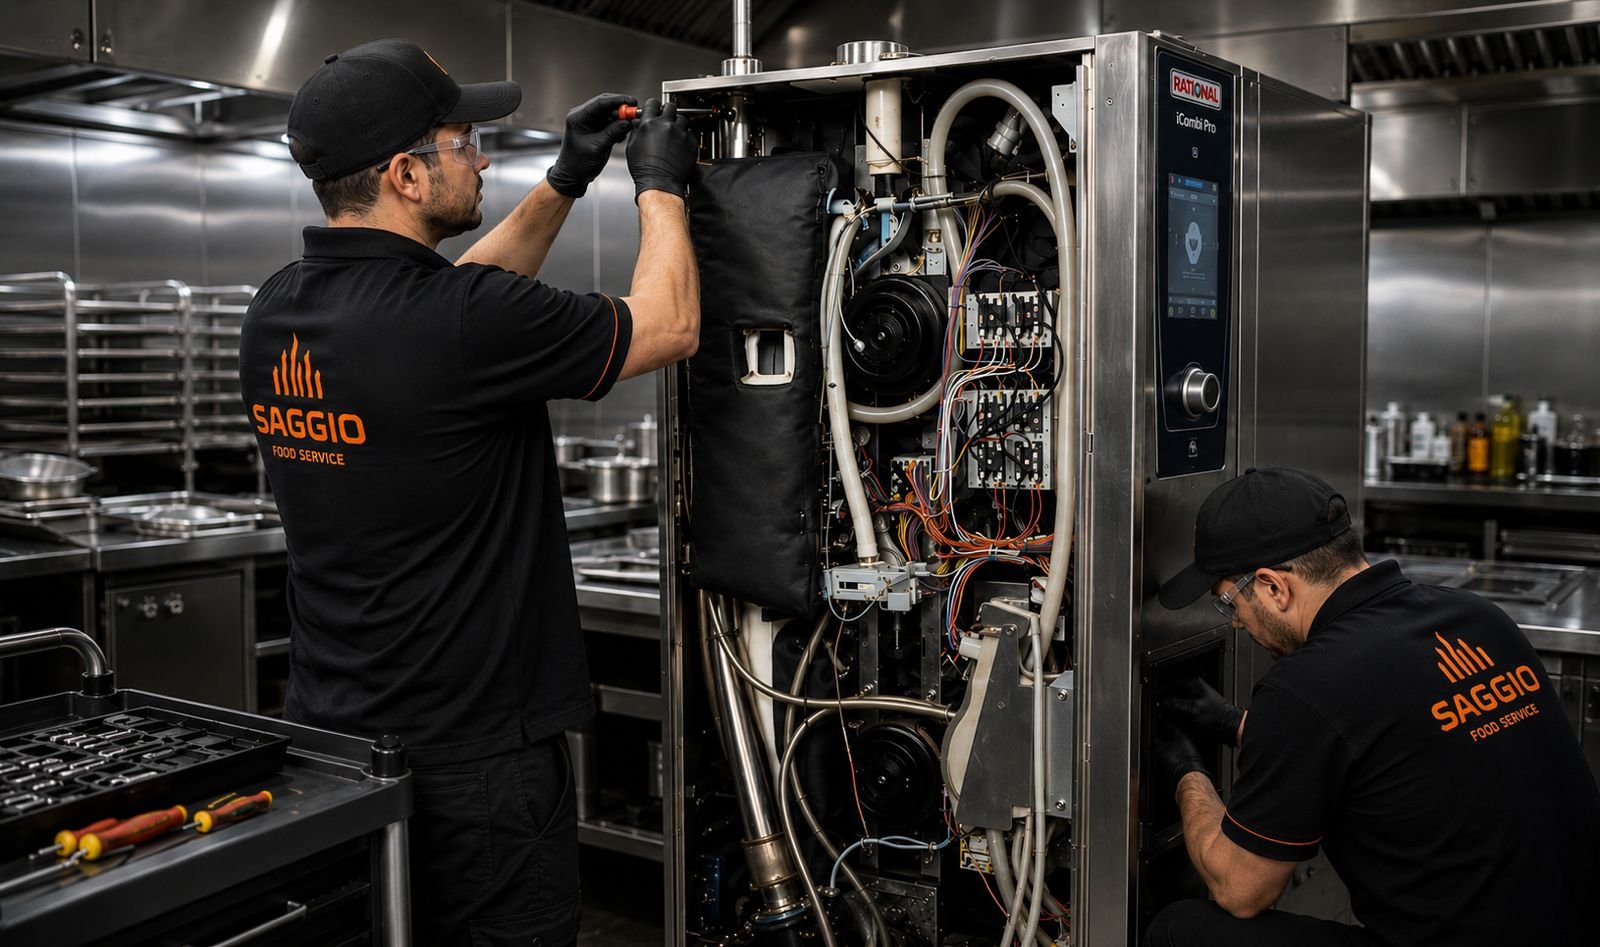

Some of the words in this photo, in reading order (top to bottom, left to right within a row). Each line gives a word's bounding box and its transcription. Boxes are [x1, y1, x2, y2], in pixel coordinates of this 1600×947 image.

[1173, 75, 1219, 104] RATIONAL
[1176, 111, 1203, 131] iCombi
[1203, 118, 1217, 134] Pro
[252, 403, 367, 446] SAGGIO
[272, 445, 297, 460] FOOD
[299, 449, 345, 466] SERVICE
[1431, 664, 1541, 732] SAGGIO
[1470, 721, 1500, 742] FOOD
[1499, 703, 1540, 728] SERVICE
